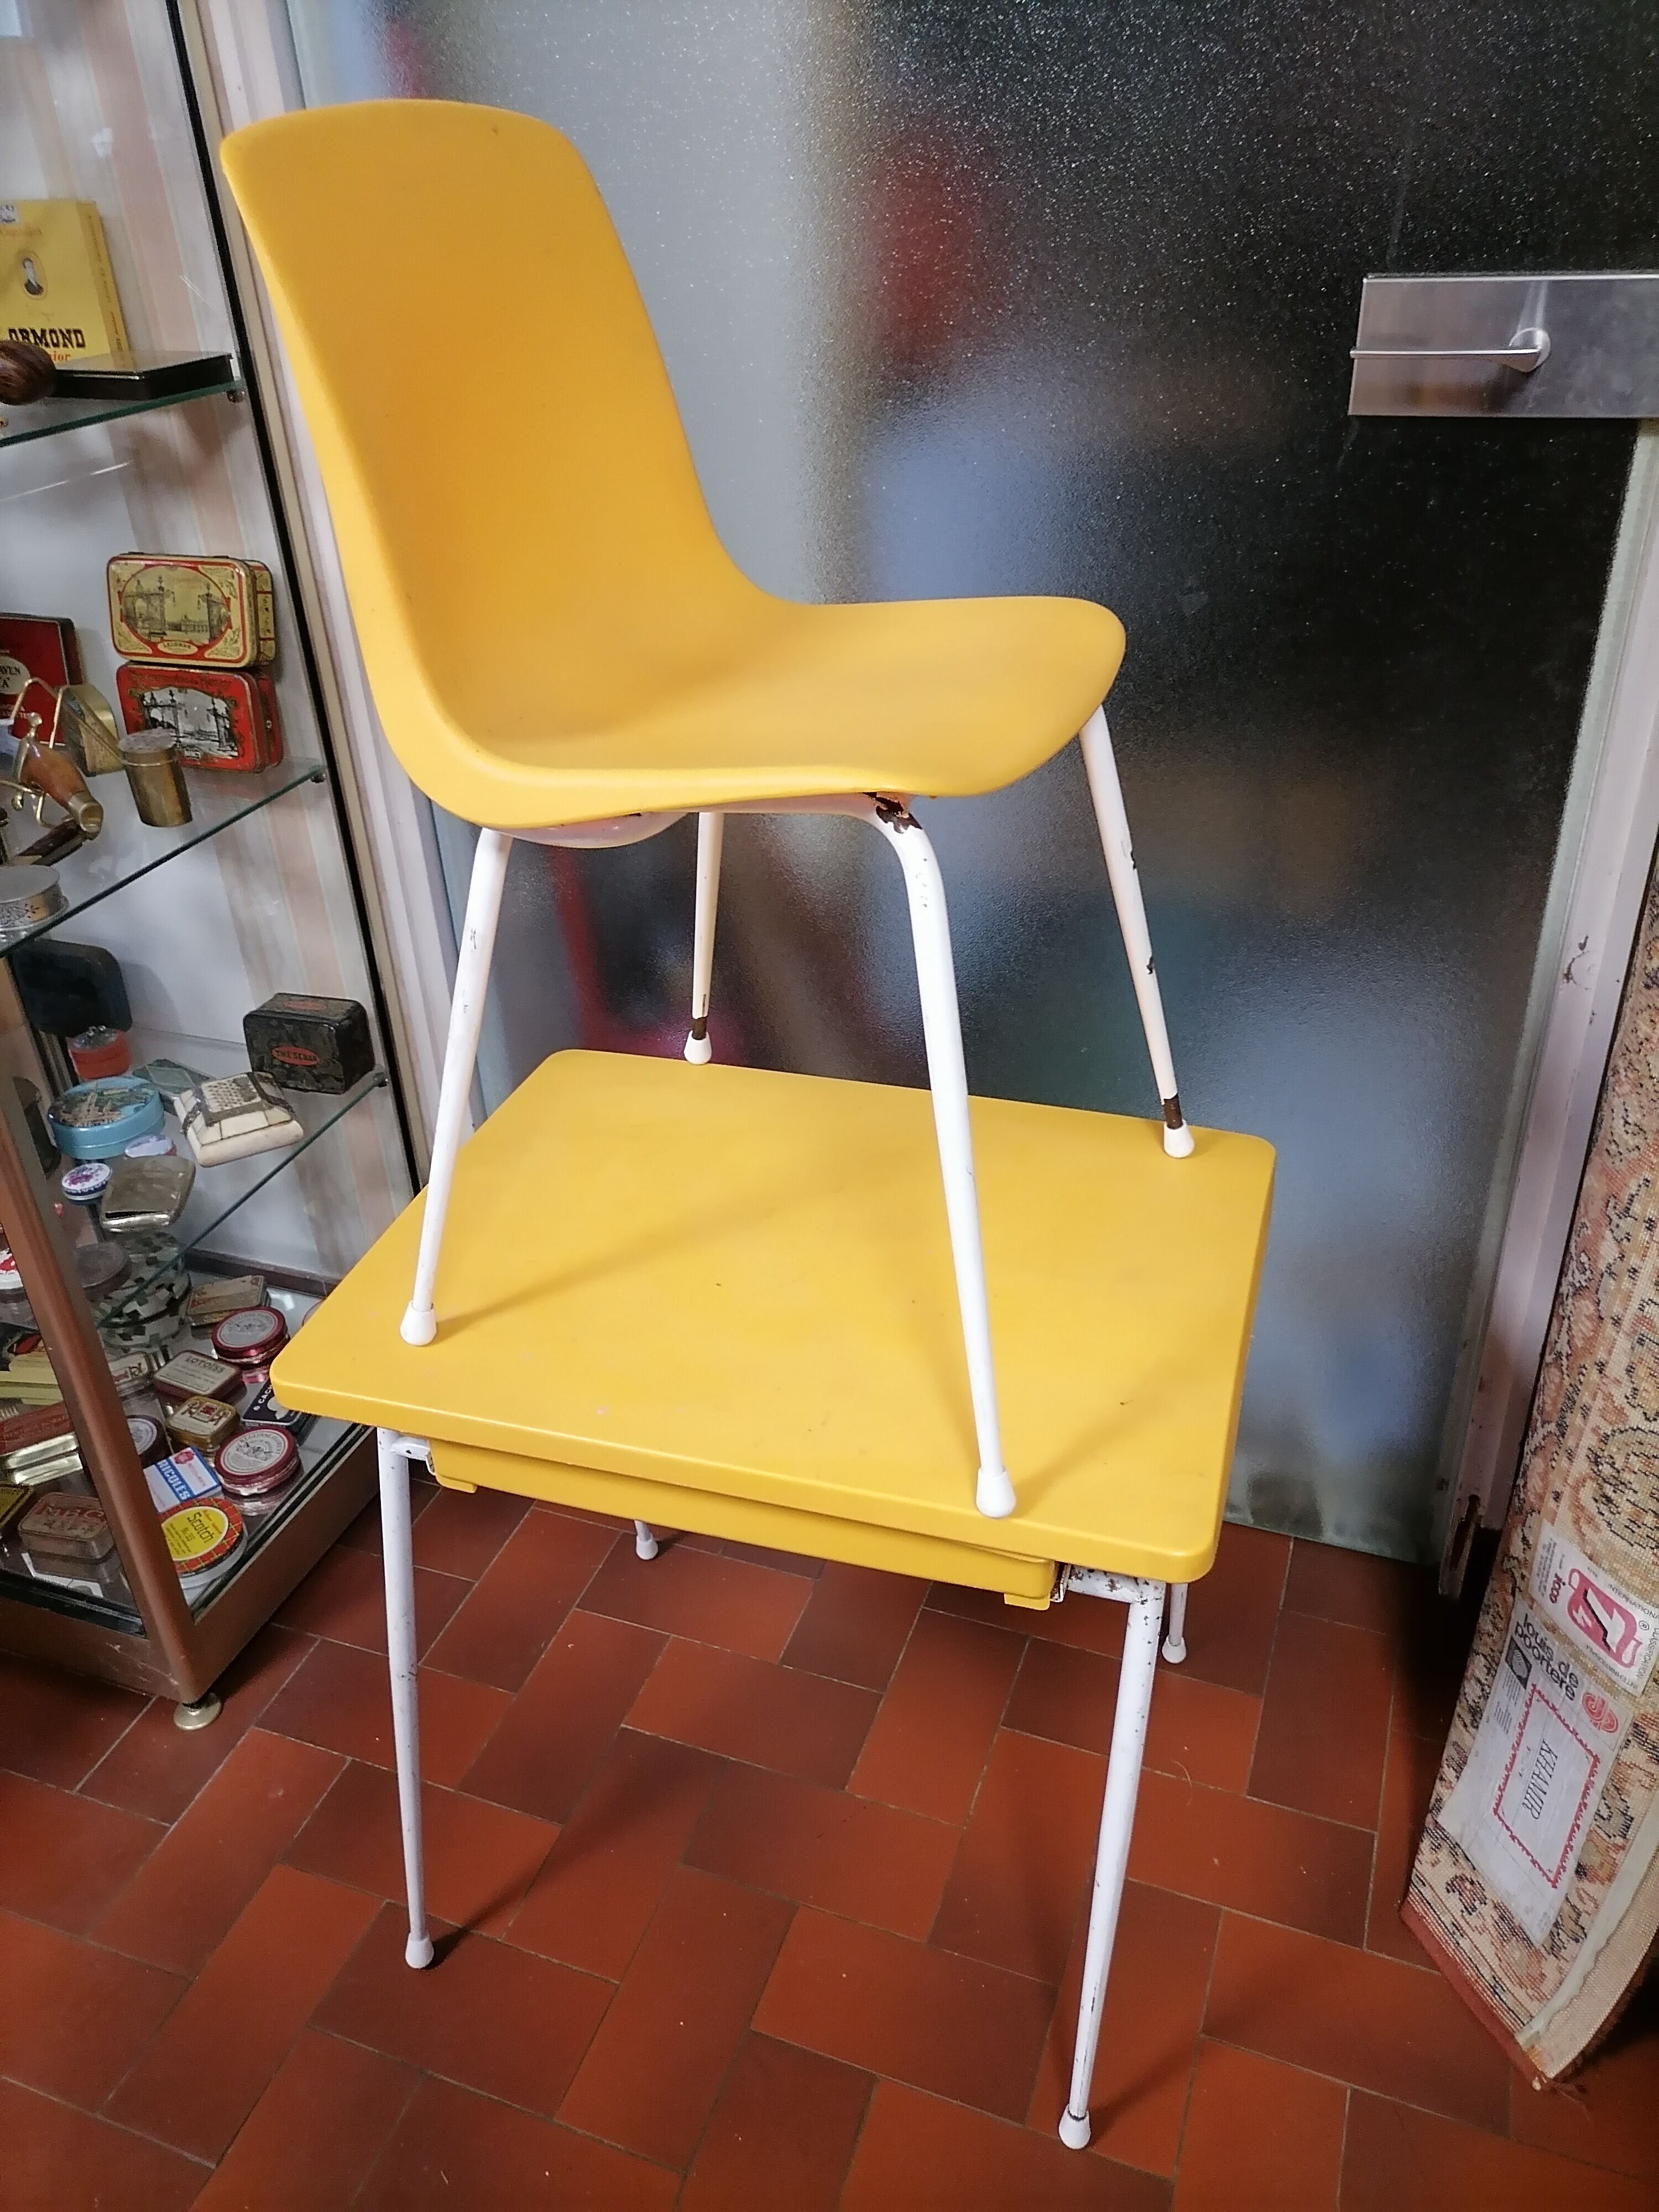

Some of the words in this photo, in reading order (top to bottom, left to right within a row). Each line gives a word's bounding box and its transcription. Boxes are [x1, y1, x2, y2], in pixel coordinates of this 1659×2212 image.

[187, 1510, 213, 1543] Scotch
[1608, 1583, 1659, 1620] INTERNATIONA
[1523, 1613, 1554, 1662] louis
[1558, 1660, 1579, 1688] de
[1522, 1738, 1558, 1819] KHAMIR
